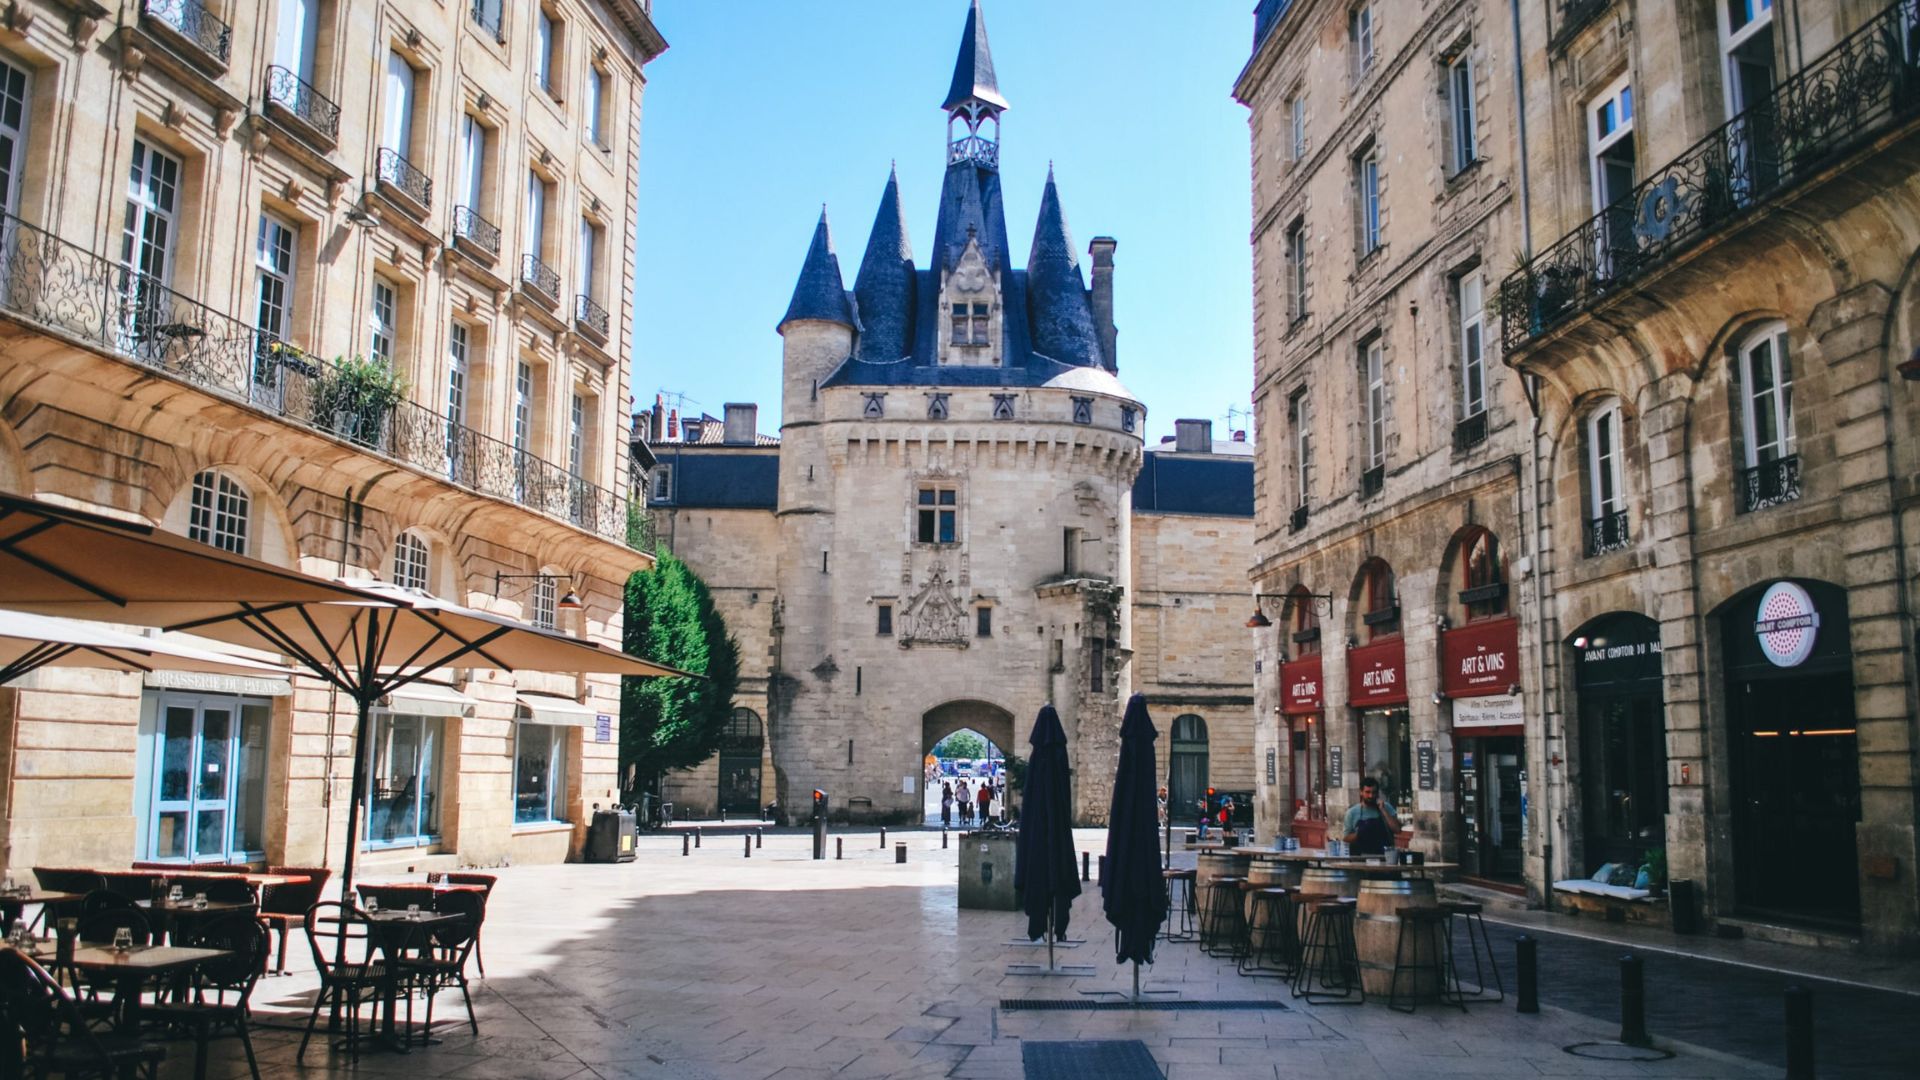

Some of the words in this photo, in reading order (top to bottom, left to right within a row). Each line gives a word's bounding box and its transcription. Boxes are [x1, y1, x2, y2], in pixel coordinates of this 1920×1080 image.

[1584, 648, 1605, 662] AVANT
[1607, 644, 1634, 659] COMPTOIR
[1637, 643, 1646, 655] DU
[1650, 641, 1664, 653] PAL
[1461, 656, 1477, 675] ART
[1477, 655, 1485, 673] &
[1485, 652, 1504, 672] VINS
[158, 671, 220, 690] BRASSERIE
[225, 677, 239, 690] DU
[244, 679, 280, 693] PALAIS
[1363, 671, 1375, 687] ART
[1375, 670, 1381, 686] &
[1381, 668, 1395, 684] VINS
[1292, 683, 1301, 697] ART
